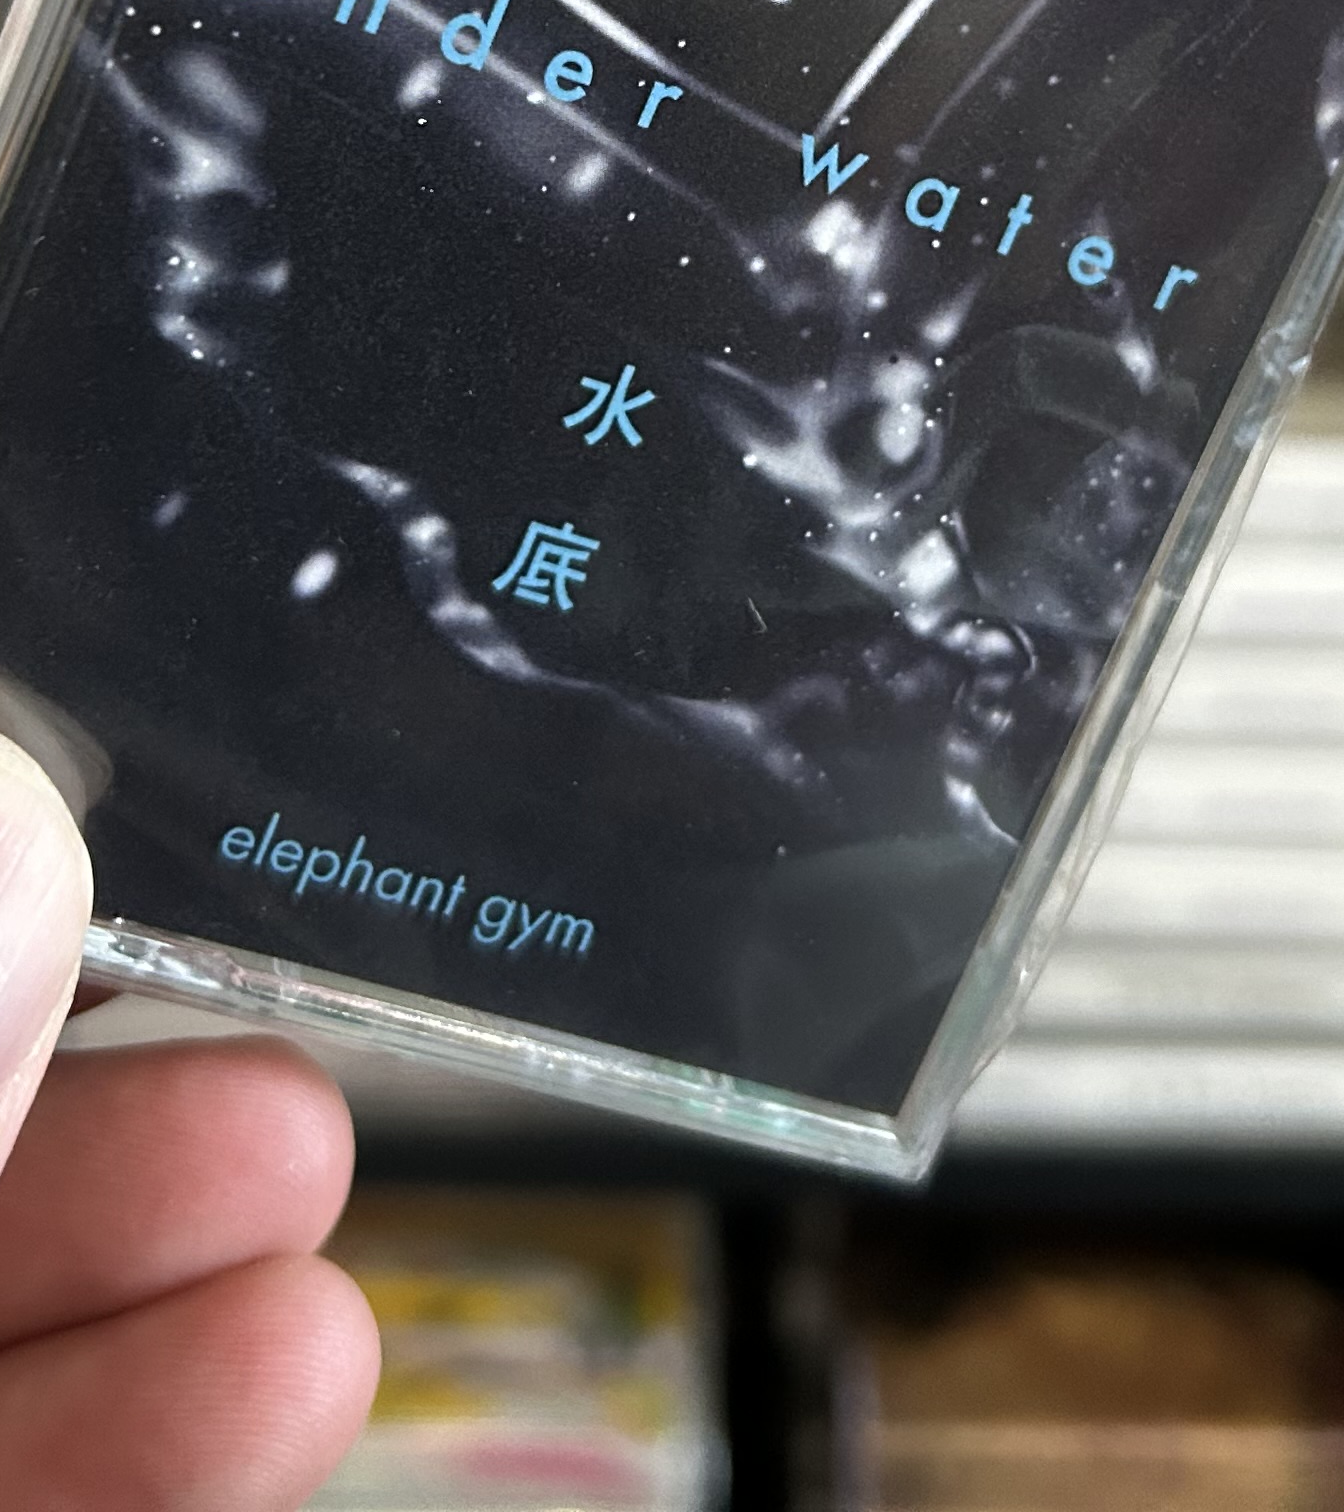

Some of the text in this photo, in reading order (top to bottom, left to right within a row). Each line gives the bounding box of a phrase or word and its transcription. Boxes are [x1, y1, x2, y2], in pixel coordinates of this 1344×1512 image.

[801, 134, 1197, 311] water
[492, 364, 656, 611] 水底
[220, 811, 595, 953] elephant gym
